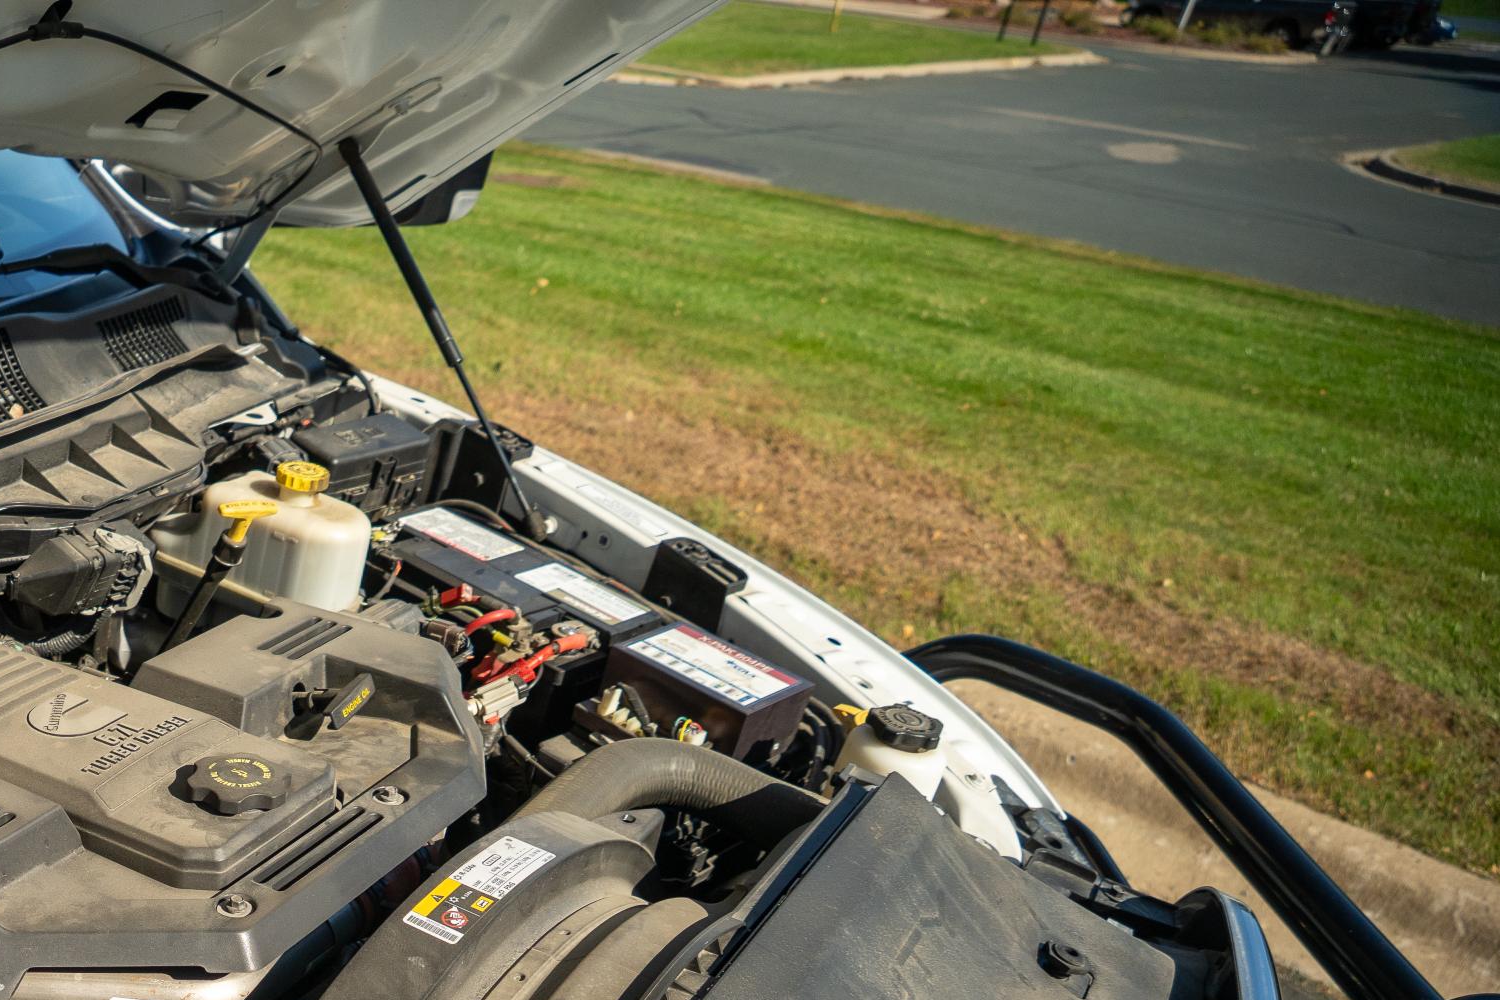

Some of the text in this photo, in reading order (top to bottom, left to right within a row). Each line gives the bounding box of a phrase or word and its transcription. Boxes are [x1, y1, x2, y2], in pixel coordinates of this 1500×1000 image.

[342, 688, 370, 717] ENGINE OIL
[81, 716, 192, 776] TURBO DIESEL
[93, 723, 144, 747] 6.7L
